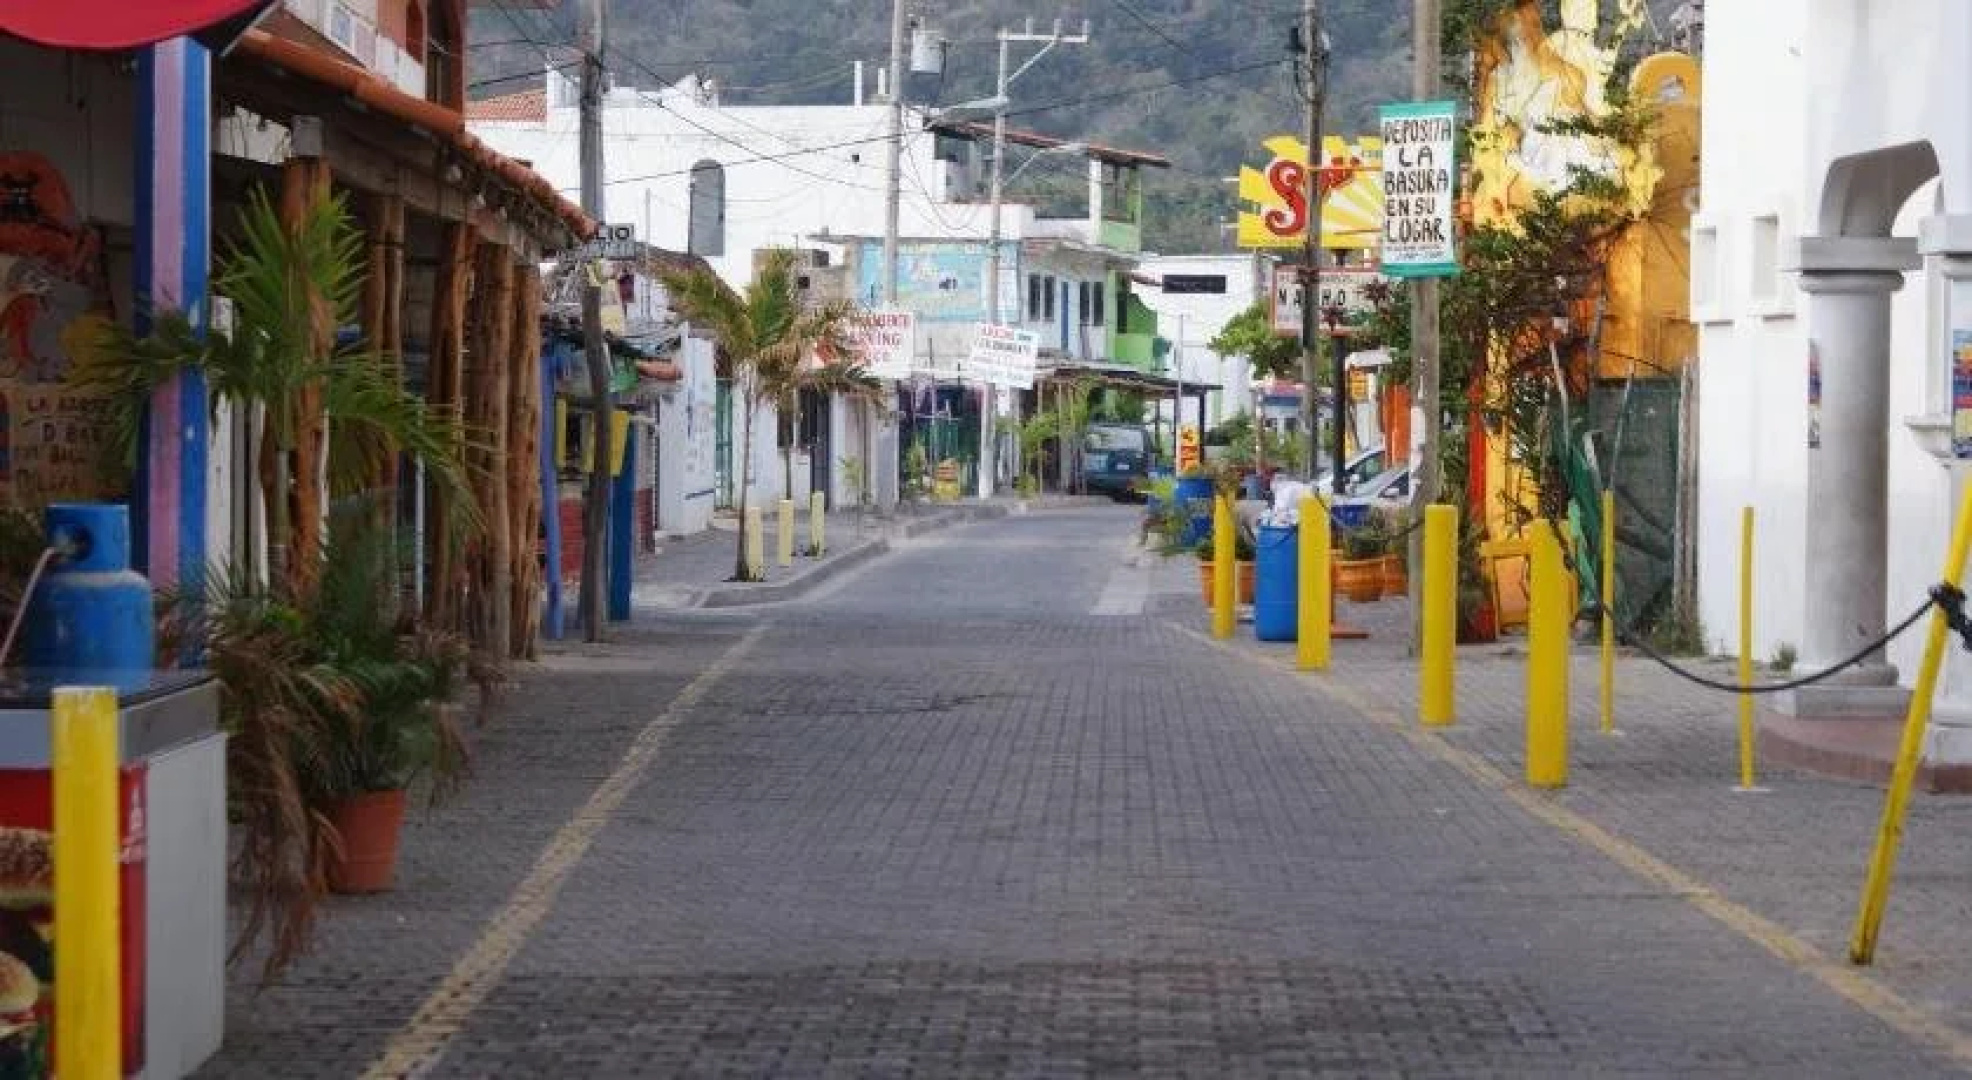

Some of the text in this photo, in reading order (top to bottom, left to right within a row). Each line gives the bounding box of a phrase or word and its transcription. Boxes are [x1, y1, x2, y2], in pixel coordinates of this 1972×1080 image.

[1384, 118, 1451, 144] DEPOSITA
[1398, 146, 1433, 168] LA
[1385, 169, 1449, 196] BASURA
[1386, 196, 1436, 218] EN SU
